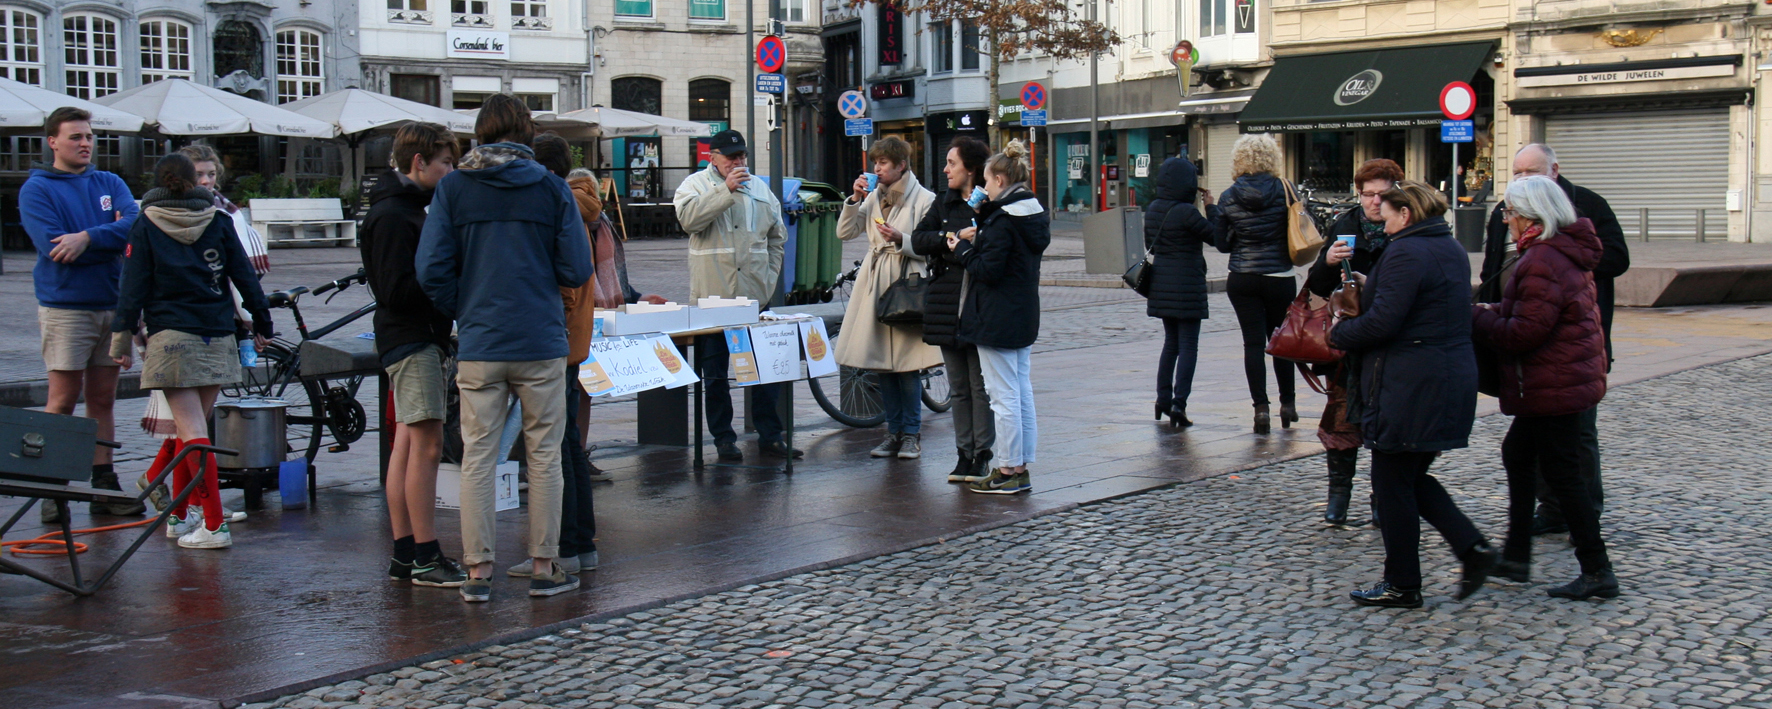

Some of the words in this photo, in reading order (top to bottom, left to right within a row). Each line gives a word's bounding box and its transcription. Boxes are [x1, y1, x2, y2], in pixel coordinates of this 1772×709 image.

[885, 0, 895, 47] ARIS
[453, 37, 489, 50] Corsendonk
[492, 38, 504, 51] bier
[1591, 73, 1617, 81] WILDE
[1625, 70, 1664, 79] JUWELEN
[1345, 79, 1365, 91] OIL
[1004, 105, 1015, 113] YVES
[203, 248, 223, 296] CRO
[591, 341, 612, 352] MUSIC
[622, 339, 639, 348] LIFE
[609, 357, 648, 378] Kodiel
